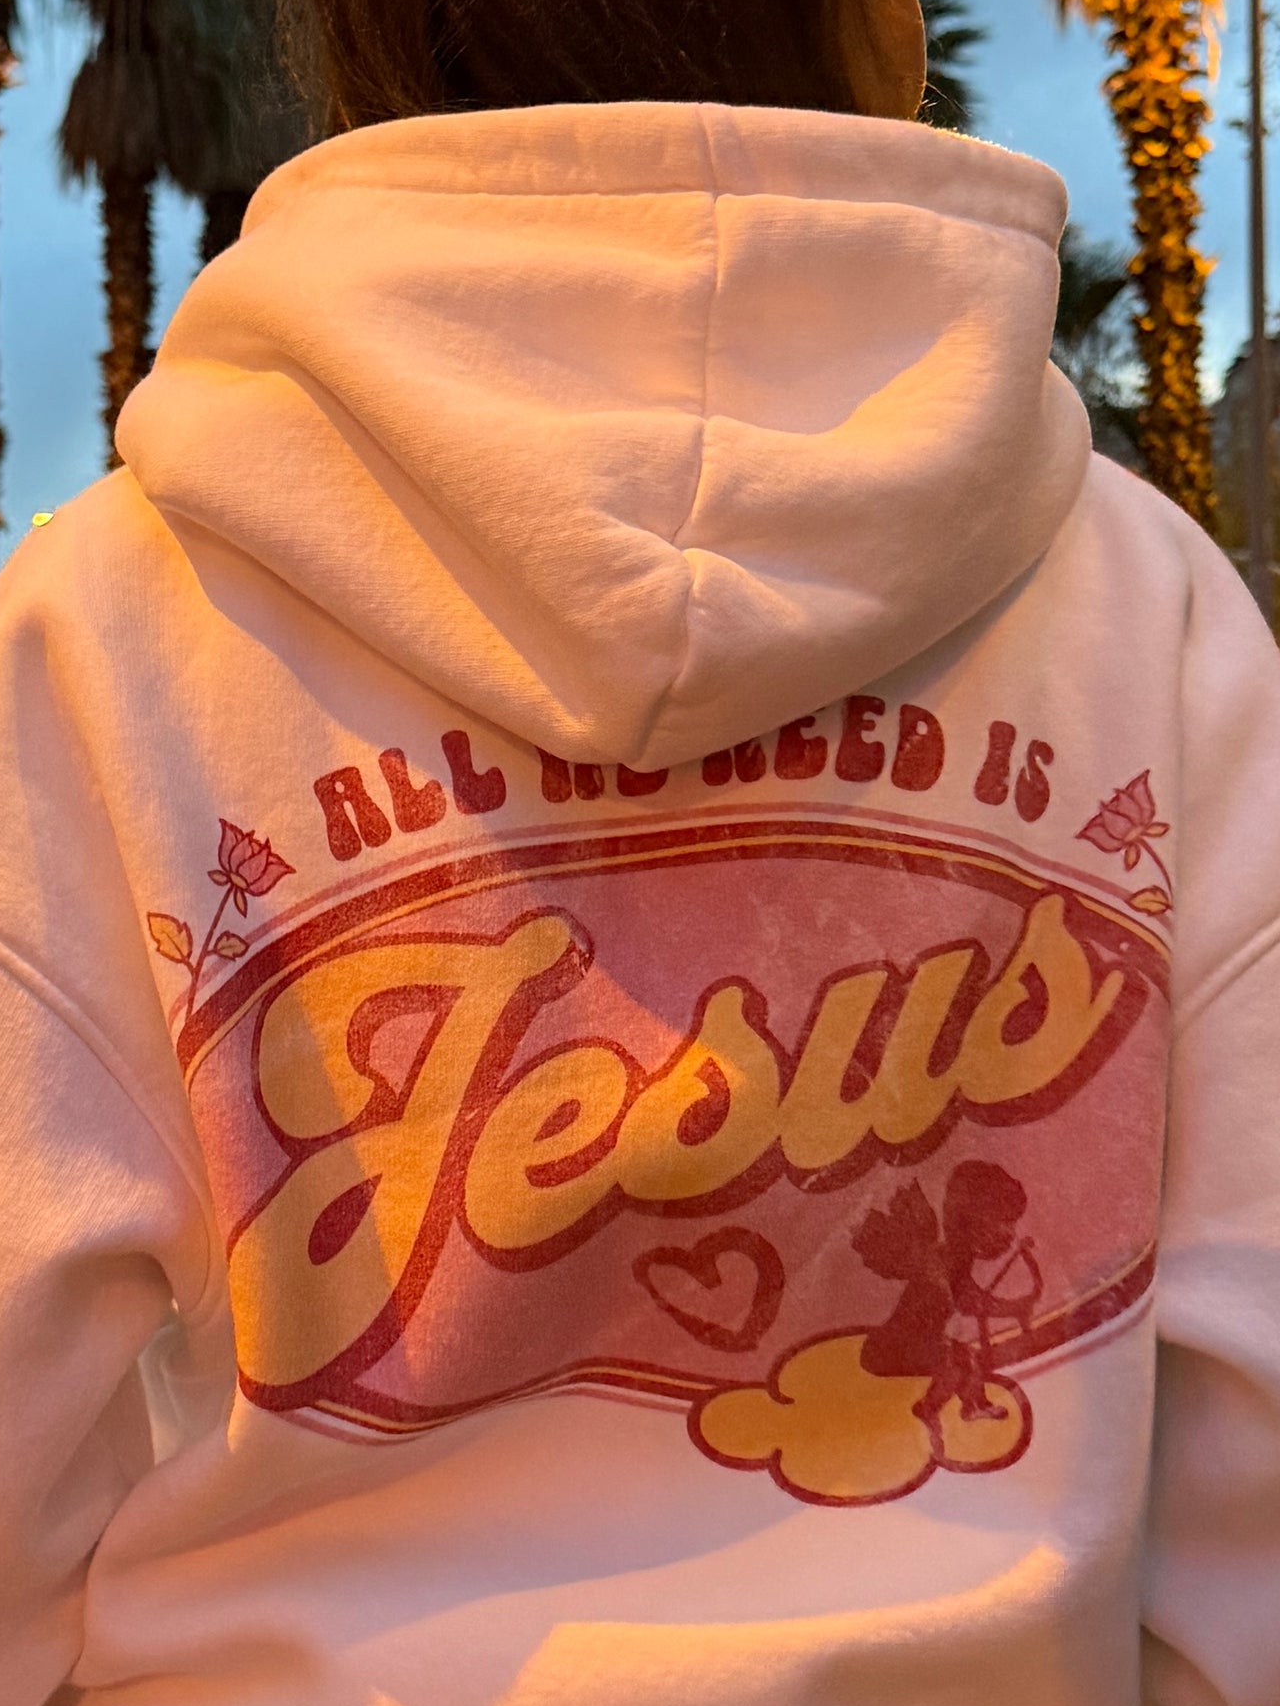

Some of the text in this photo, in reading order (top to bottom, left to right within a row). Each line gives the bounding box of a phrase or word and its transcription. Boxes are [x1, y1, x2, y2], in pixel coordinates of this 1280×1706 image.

[313, 729, 507, 861] ALL
[974, 720, 1055, 822] IS
[228, 889, 1142, 1407] Jesus
